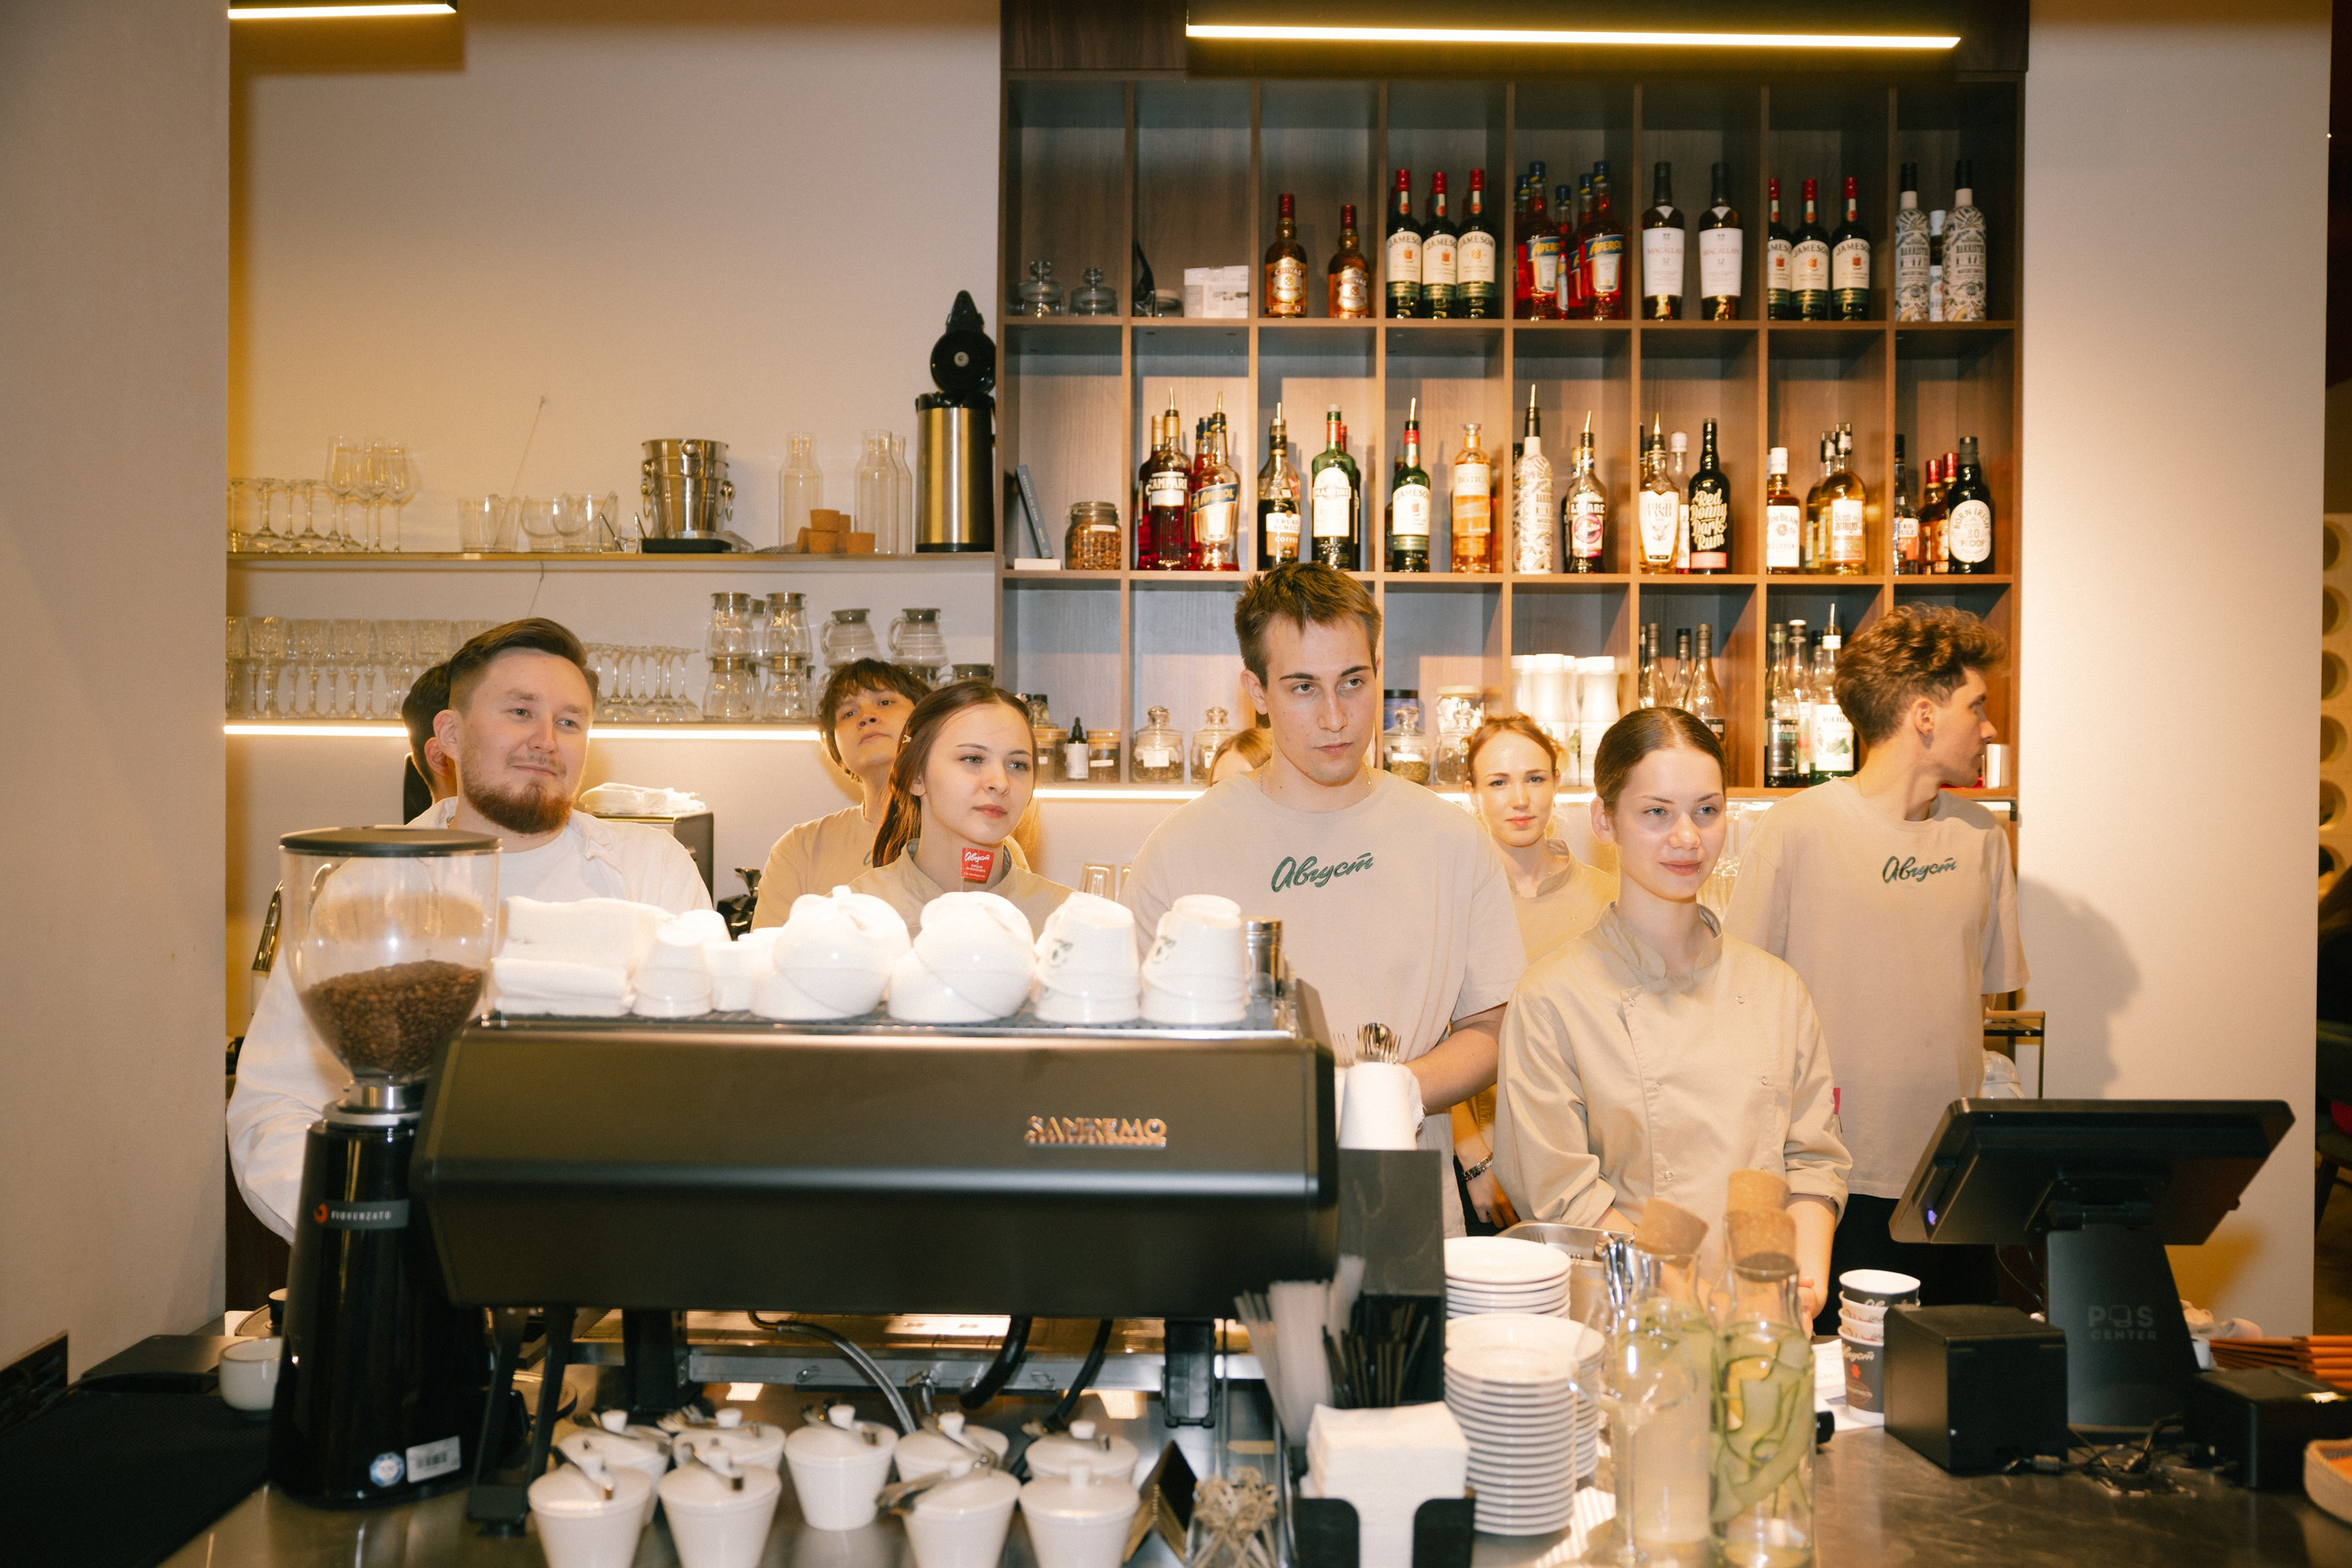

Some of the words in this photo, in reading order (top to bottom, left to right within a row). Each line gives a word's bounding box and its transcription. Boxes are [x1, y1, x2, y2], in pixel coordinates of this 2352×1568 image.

[1274, 267, 1303, 276] CHIVAS
[1692, 488, 1723, 506] Red
[1690, 503, 1727, 524] Bonny
[1953, 507, 1972, 530] BORN
[1691, 517, 1727, 536] Dark
[1694, 534, 1725, 551] Rum
[1271, 852, 1374, 893] Август
[1883, 855, 1956, 884] Август
[331, 1210, 392, 1221] FIORENZATO
[2091, 1329, 2157, 1341] CENTER
